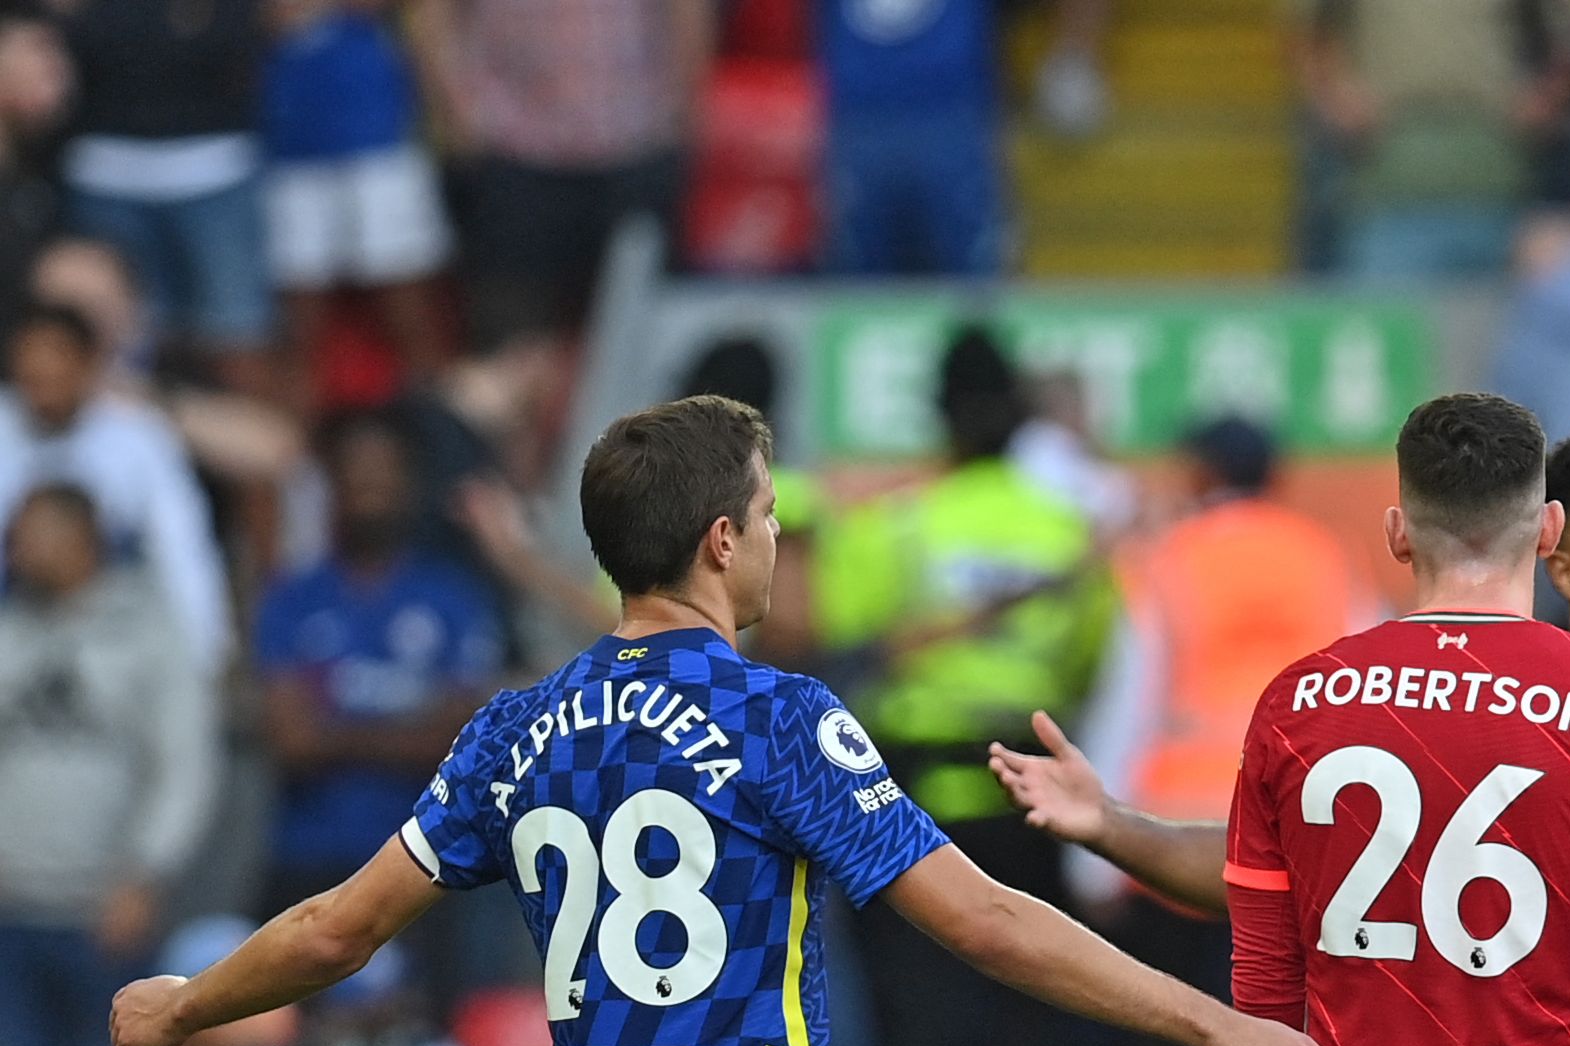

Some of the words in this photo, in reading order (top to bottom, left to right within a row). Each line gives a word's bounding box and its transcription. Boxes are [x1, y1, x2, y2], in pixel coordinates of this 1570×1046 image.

[617, 647, 649, 661] CFC
[510, 788, 728, 1021] 28
[1301, 745, 1548, 978] 26
